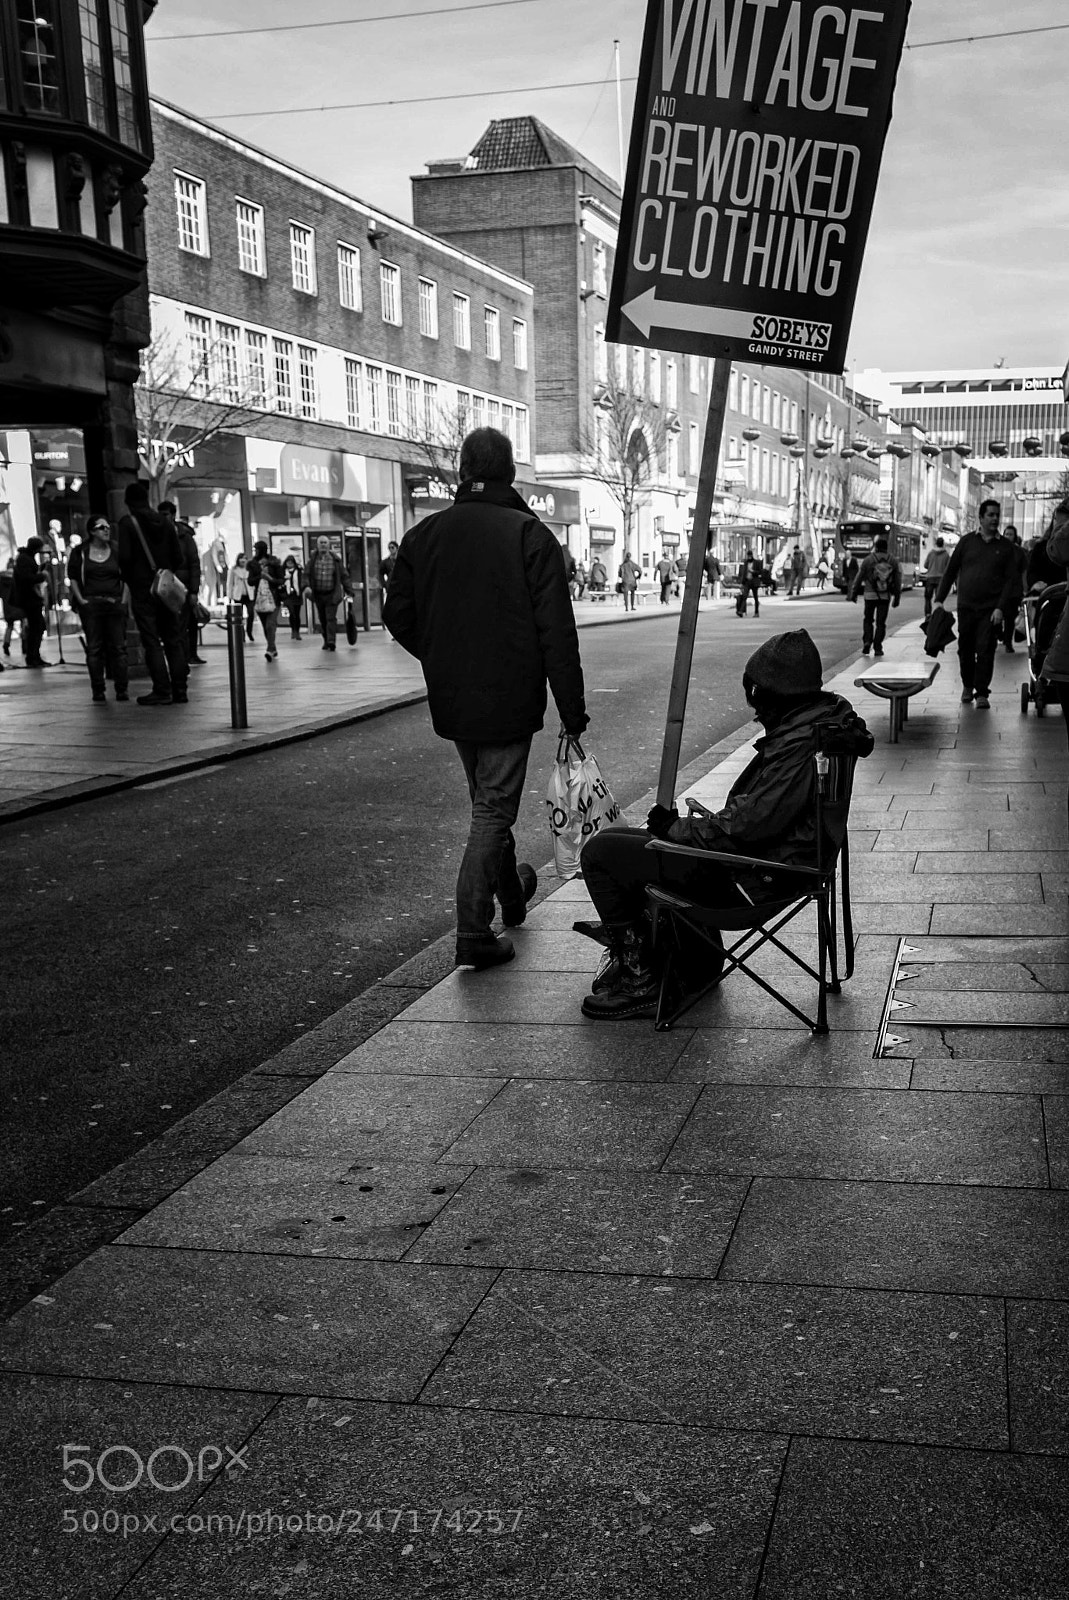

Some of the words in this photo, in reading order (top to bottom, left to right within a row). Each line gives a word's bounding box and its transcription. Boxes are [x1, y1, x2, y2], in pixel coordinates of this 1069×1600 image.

[661, 0, 885, 118] VINTAGE
[652, 95, 677, 118] AND
[640, 119, 861, 221] REWORKED
[632, 198, 847, 298] CLOTHING
[750, 315, 831, 349] SOBEYS
[748, 343, 785, 357] GANDY
[786, 348, 825, 363] STREET
[291, 458, 339, 485] Evans
